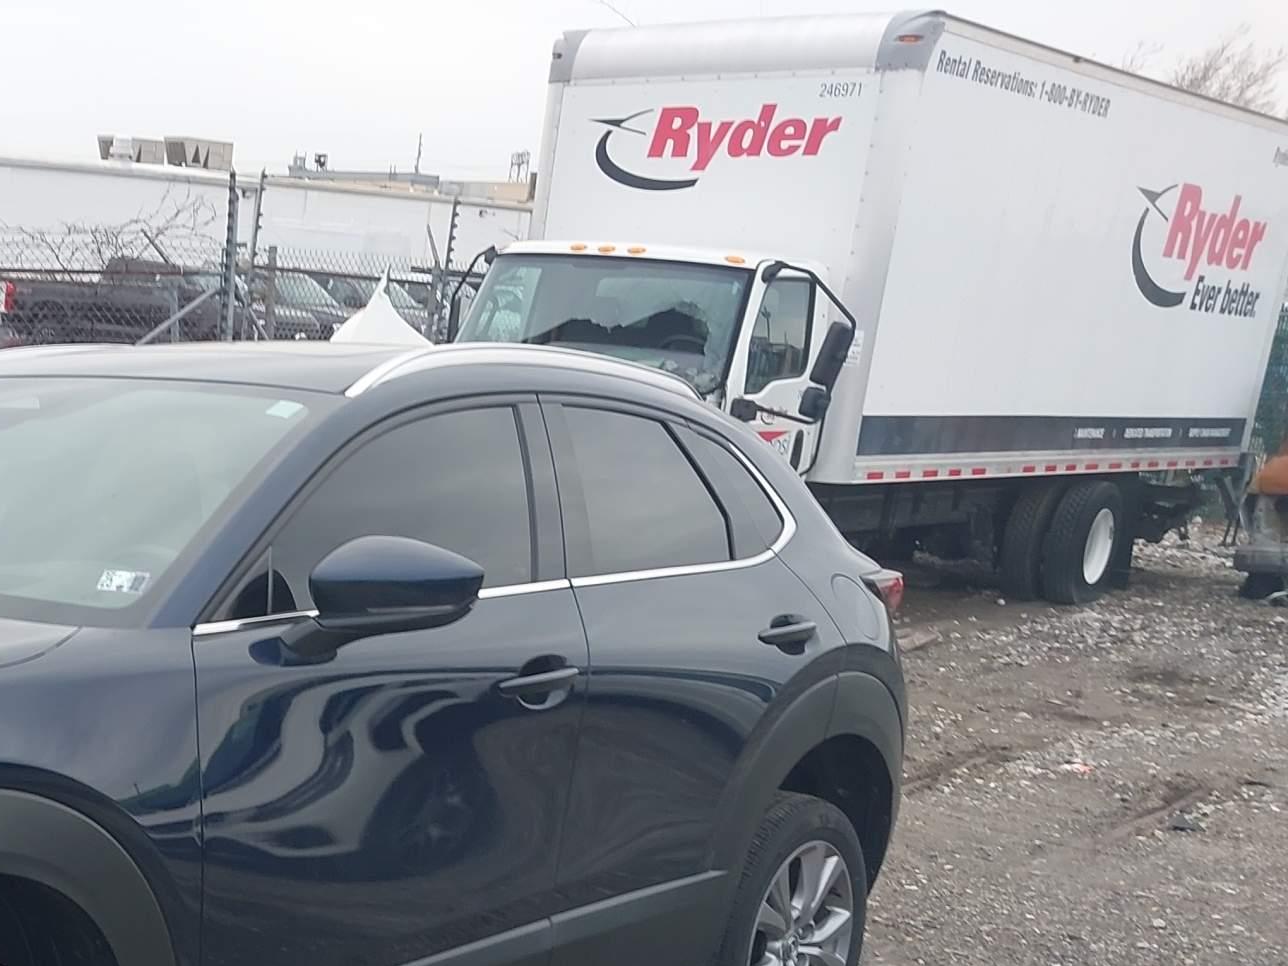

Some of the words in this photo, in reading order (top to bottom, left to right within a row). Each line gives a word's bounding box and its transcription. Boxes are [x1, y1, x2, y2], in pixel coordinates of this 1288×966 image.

[819, 82, 863, 99] 246971
[936, 50, 972, 79] Rental
[972, 60, 1038, 98] Reservations:
[1039, 80, 1112, 119] 1-800-BY-RYDER
[647, 103, 843, 171] Ryder
[1162, 182, 1268, 281] Ryder
[1189, 275, 1223, 313] Ever
